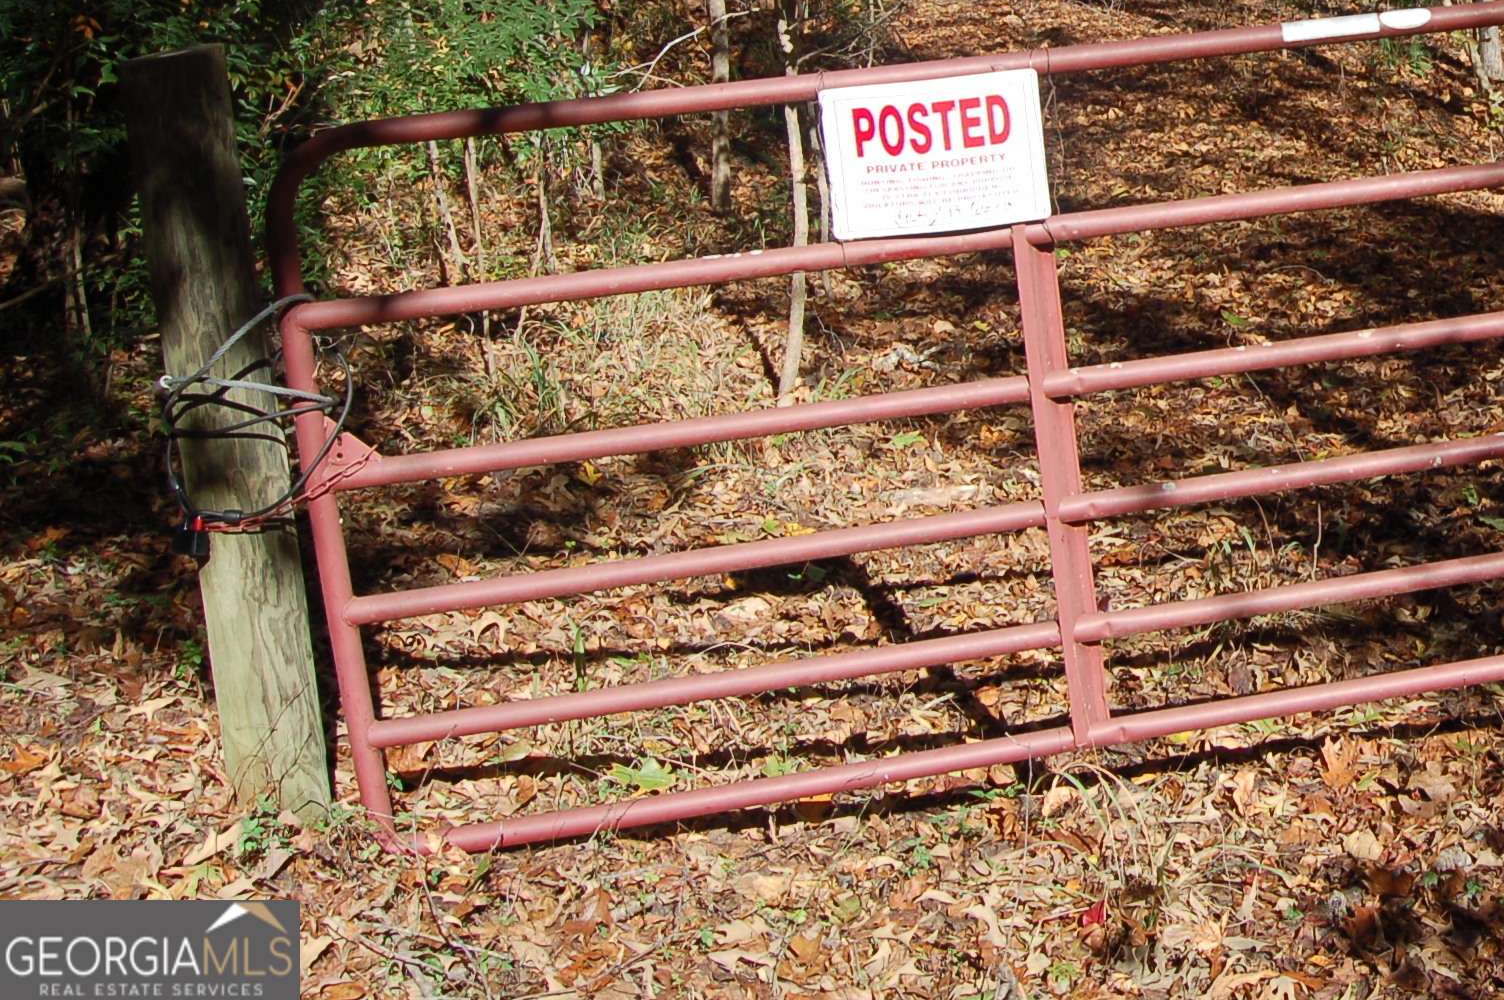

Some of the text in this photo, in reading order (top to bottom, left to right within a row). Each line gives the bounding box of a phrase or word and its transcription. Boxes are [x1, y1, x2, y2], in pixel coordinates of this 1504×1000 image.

[851, 94, 1011, 158] POSTED
[866, 153, 1007, 175] PRIVATE PROPERTY
